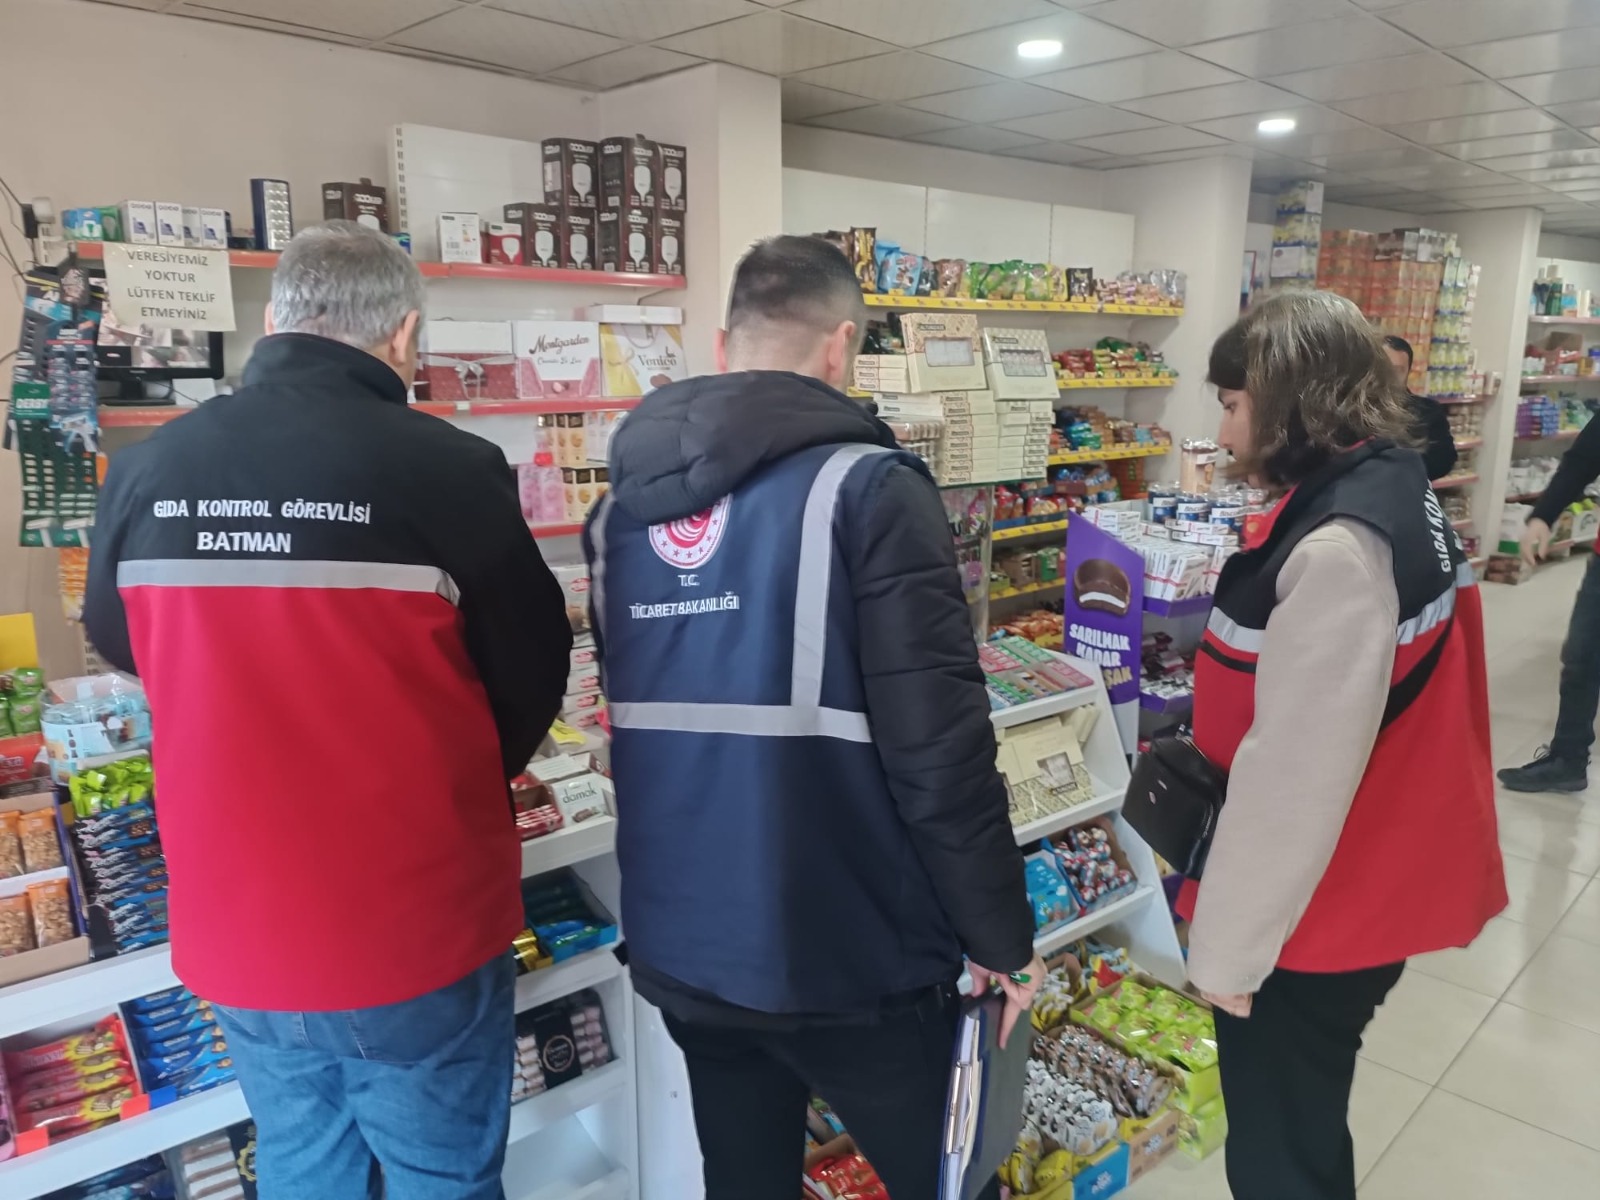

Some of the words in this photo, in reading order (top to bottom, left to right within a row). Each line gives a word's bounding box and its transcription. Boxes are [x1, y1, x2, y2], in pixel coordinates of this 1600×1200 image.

[127, 250, 208, 266] VERESİYEMİZ
[145, 269, 195, 282] YOKTUR
[127, 286, 174, 300] LÜTFEN
[178, 290, 215, 302] TEKLİF
[141, 306, 206, 320] ETMEYİNİZ
[153, 499, 189, 518] GIDA
[197, 498, 272, 518] KONTROL
[281, 498, 371, 524] GÖREVLİSİ
[196, 531, 292, 553] BATMAN
[1430, 528, 1453, 574] GIDA
[629, 602, 678, 619] TİCARET
[677, 591, 740, 615] BAKANLIĞI
[1069, 623, 1131, 651] SARILMAK
[1076, 642, 1122, 667] KADAR
[562, 781, 598, 804] damak
